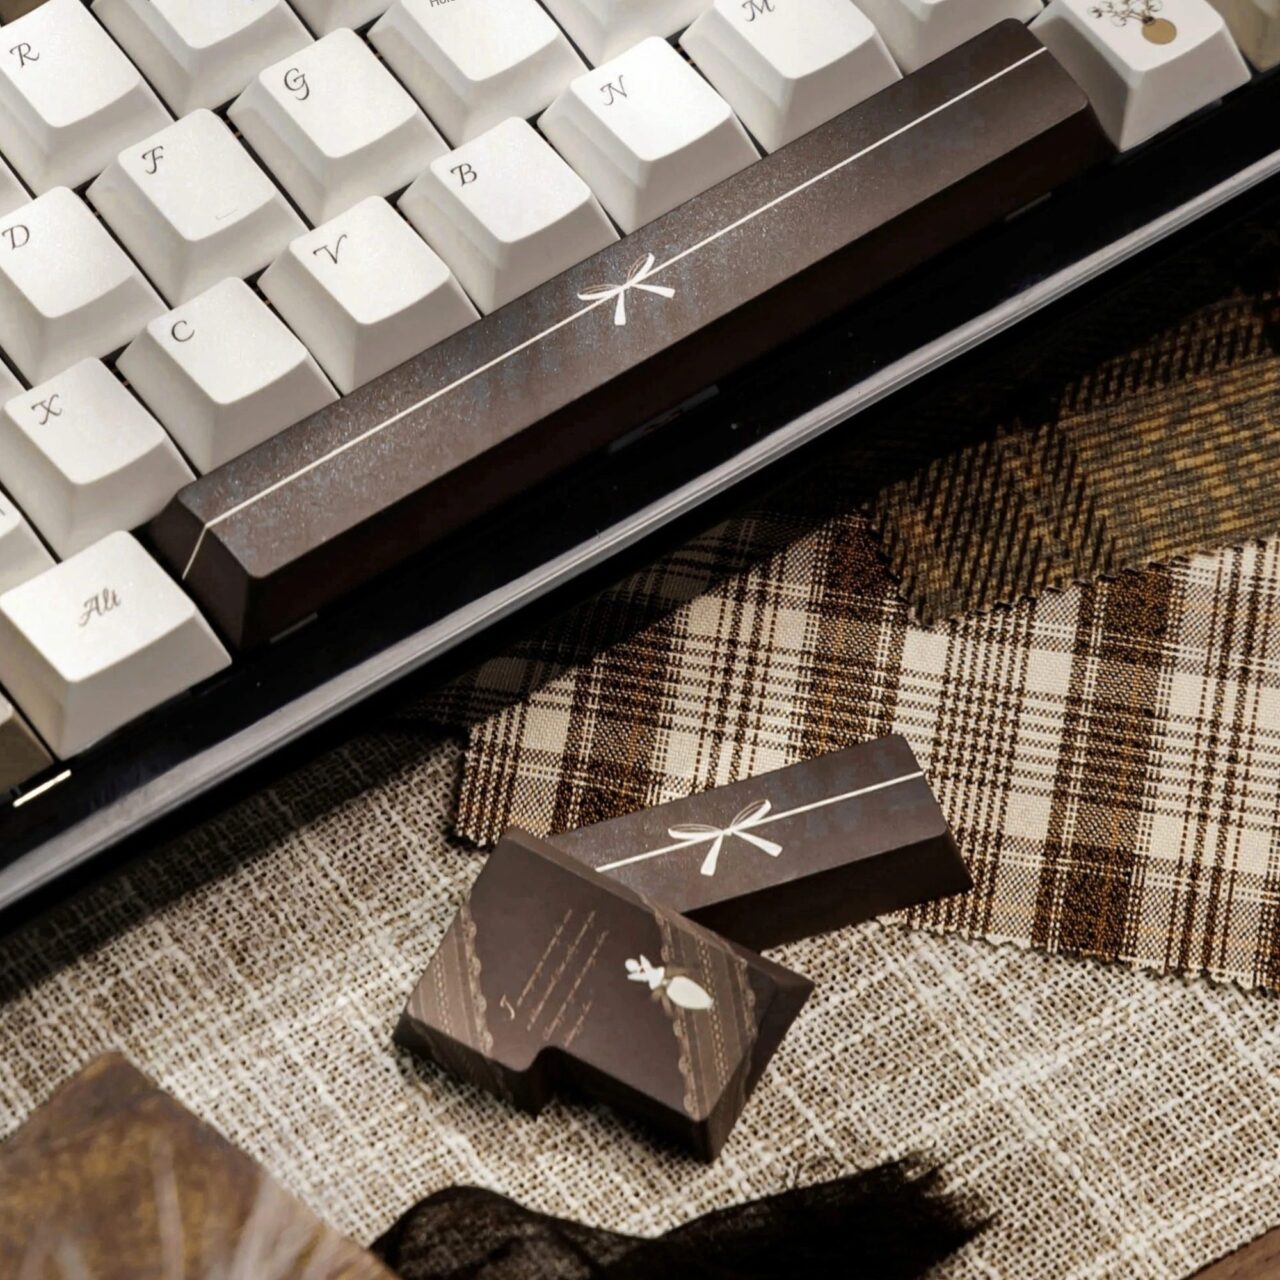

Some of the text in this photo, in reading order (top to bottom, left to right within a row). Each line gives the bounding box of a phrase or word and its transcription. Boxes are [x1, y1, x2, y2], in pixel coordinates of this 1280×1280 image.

[8, 42, 40, 68] R
[283, 67, 311, 101] G
[599, 74, 628, 106] N
[141, 145, 164, 175] F
[449, 163, 478, 187] B
[1, 224, 31, 250] D
[312, 233, 348, 265] V
[170, 320, 195, 343] C
[30, 393, 63, 426] X
[79, 587, 121, 627] Alt
